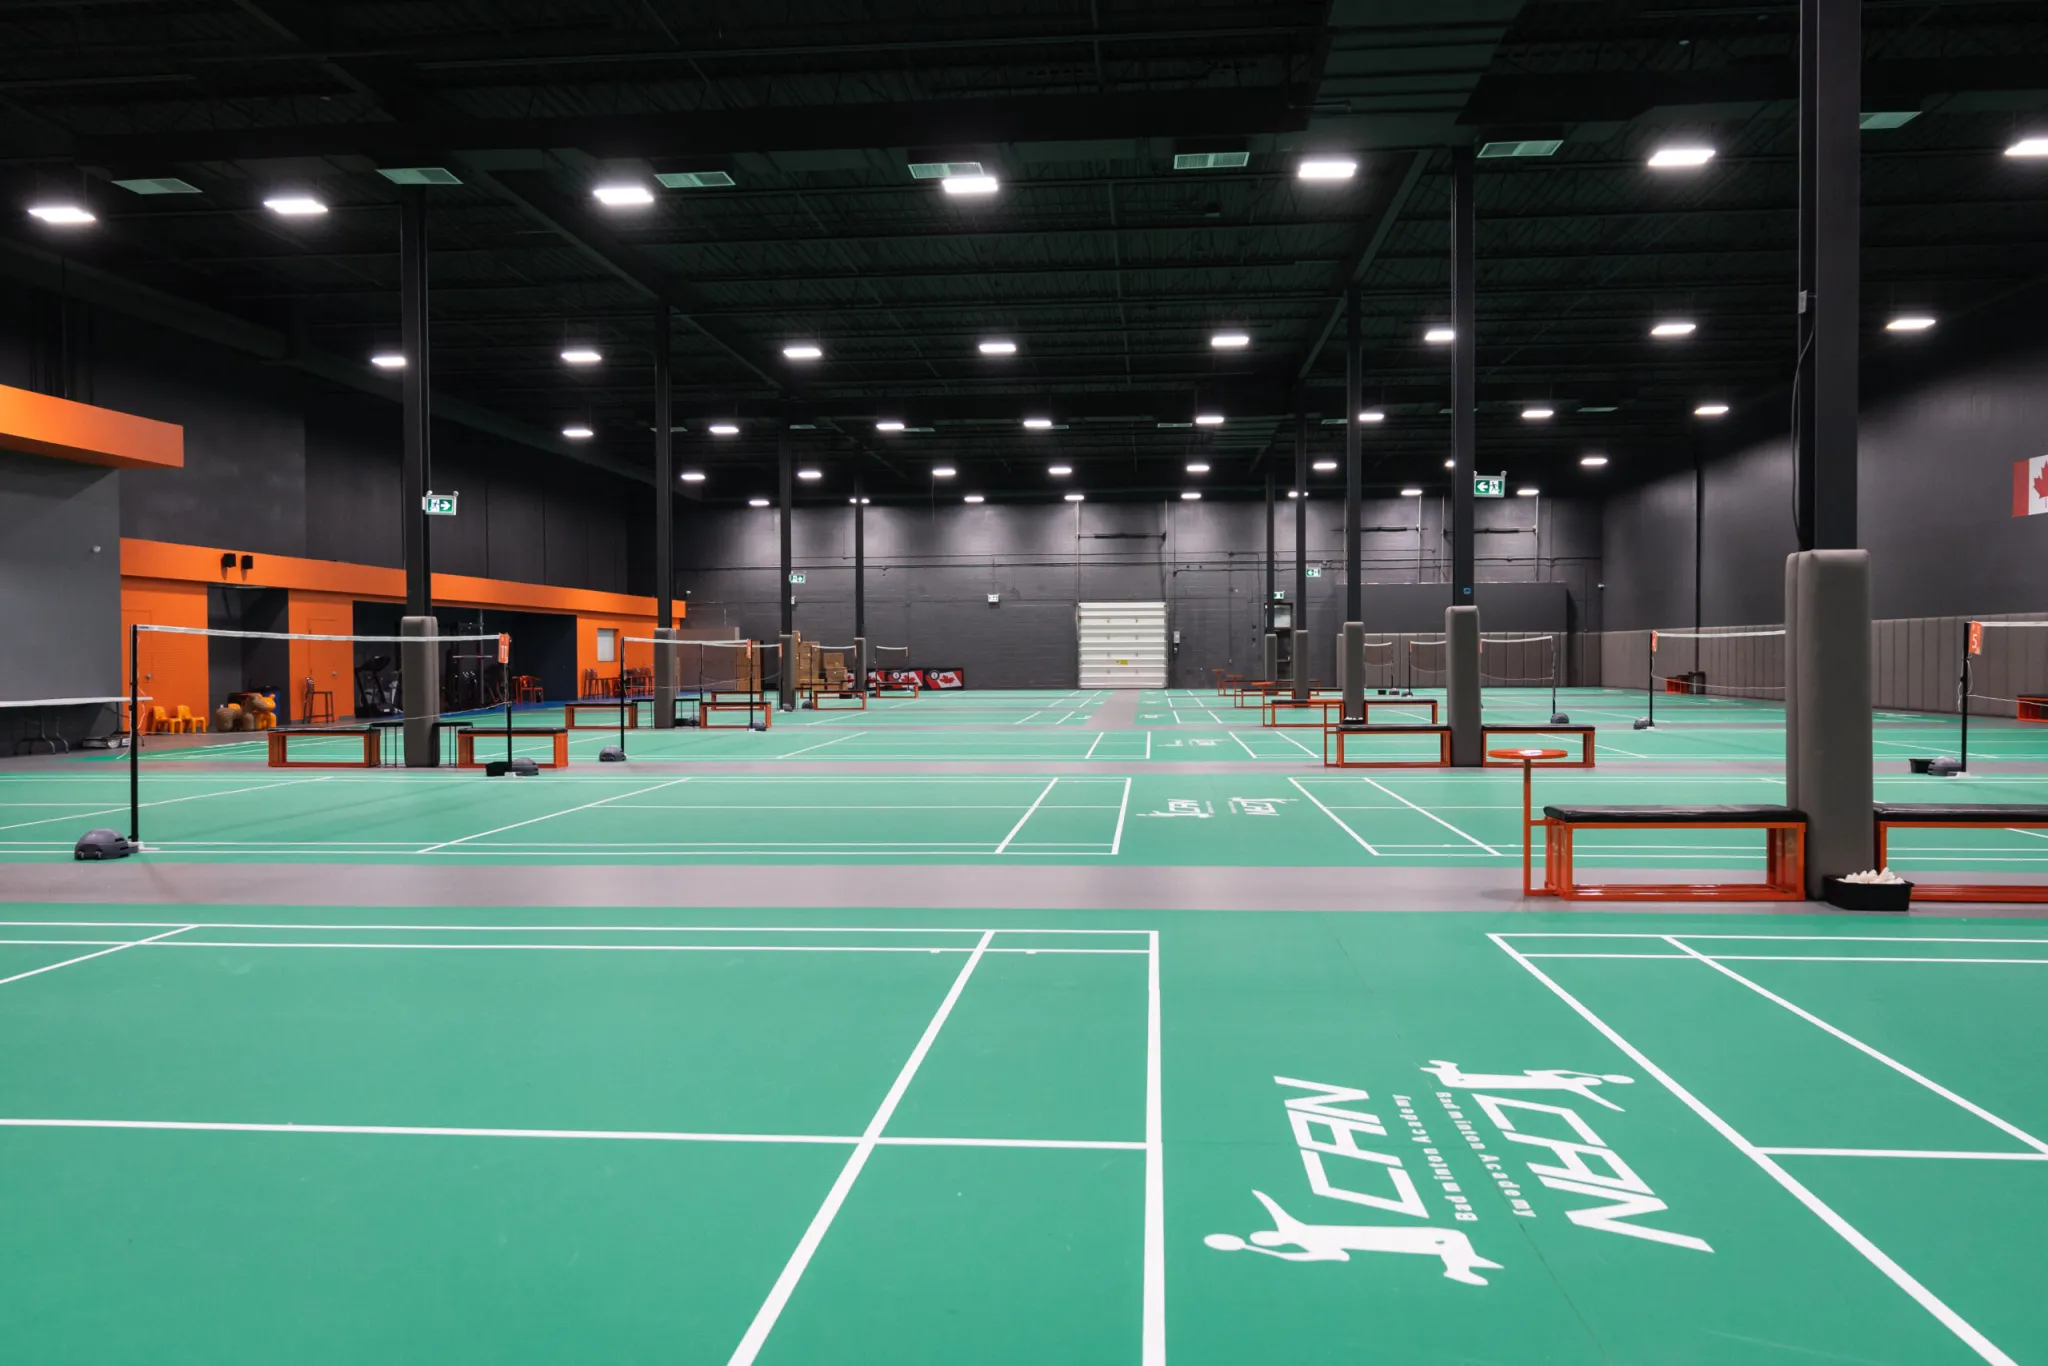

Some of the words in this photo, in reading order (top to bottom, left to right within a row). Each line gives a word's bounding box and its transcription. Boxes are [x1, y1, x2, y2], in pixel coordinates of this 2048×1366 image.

[1393, 1094, 1432, 1144] Academy
[1435, 1092, 1486, 1150] Badminton
[1478, 1154, 1537, 1217] Academy
[1423, 1147, 1478, 1221] Badminton
